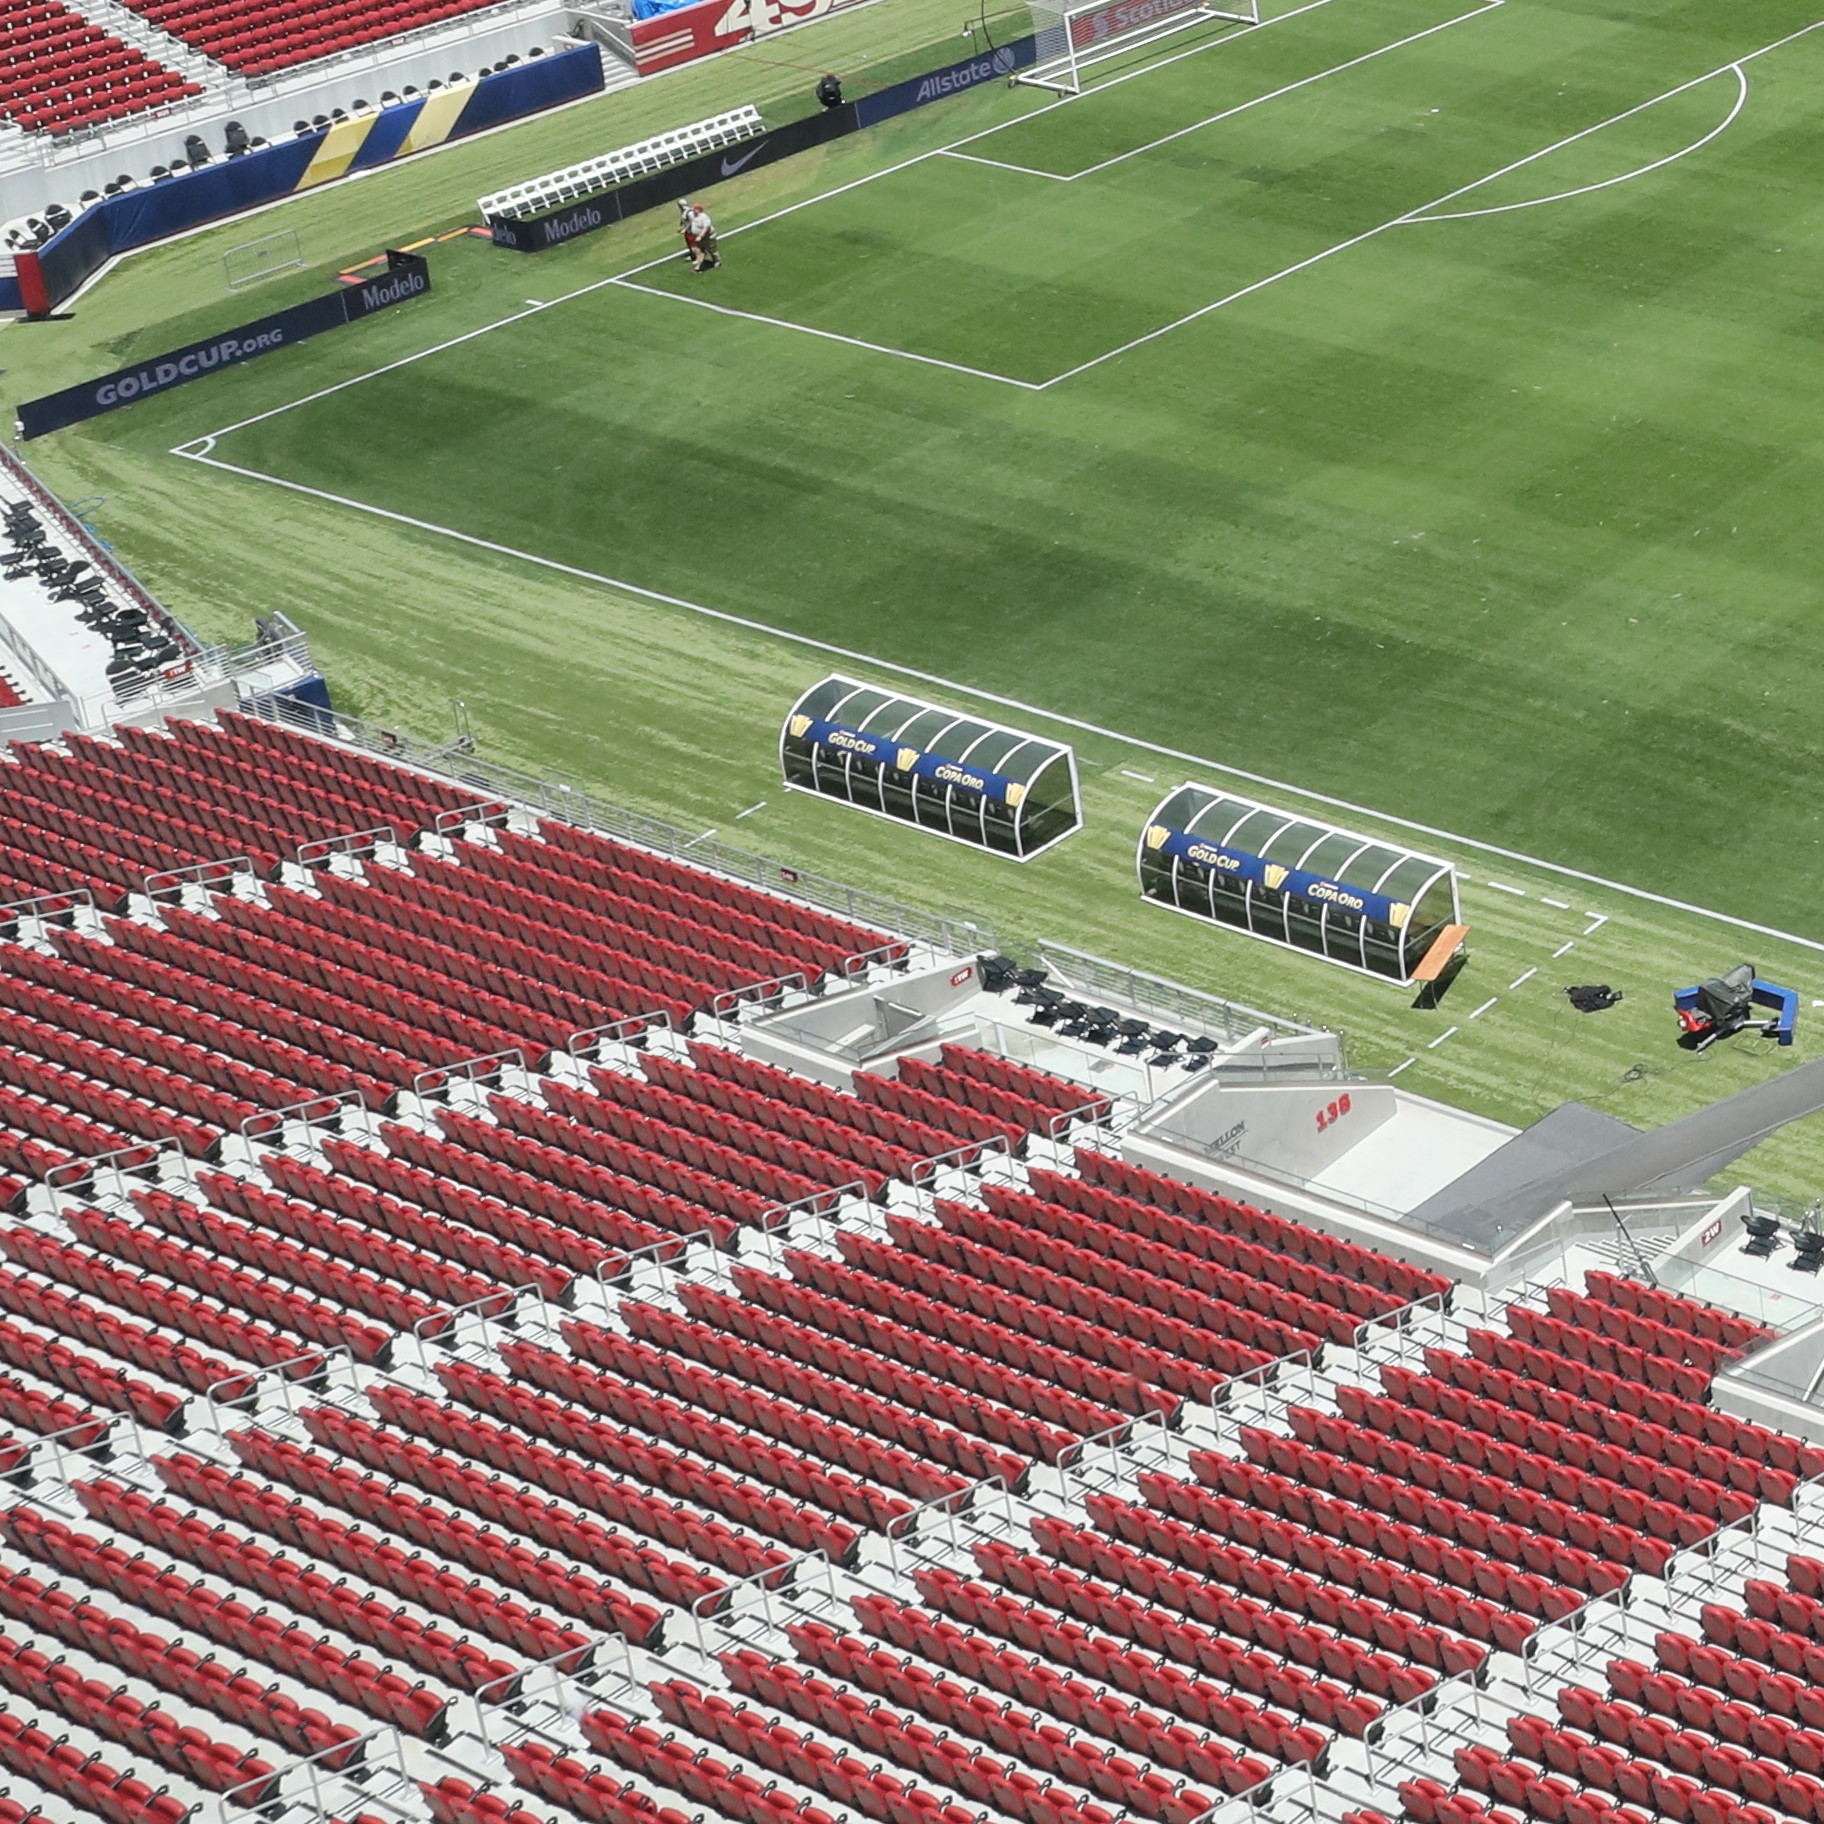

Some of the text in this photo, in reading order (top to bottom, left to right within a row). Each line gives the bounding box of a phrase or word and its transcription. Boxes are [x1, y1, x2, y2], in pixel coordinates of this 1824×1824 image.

[916, 59, 990, 102] Allstate
[544, 206, 601, 242] Modelo
[362, 269, 426, 311] Modelo
[95, 327, 284, 407] GOLDCUP.ORG
[828, 732, 855, 749] GOLD
[854, 740, 876, 754] CUP
[935, 766, 961, 784] COPA
[961, 776, 985, 790] ORO
[1187, 845, 1240, 870] GOLD CUP
[1307, 884, 1364, 910] COPA ORO
[1315, 1093, 1352, 1132] 138
